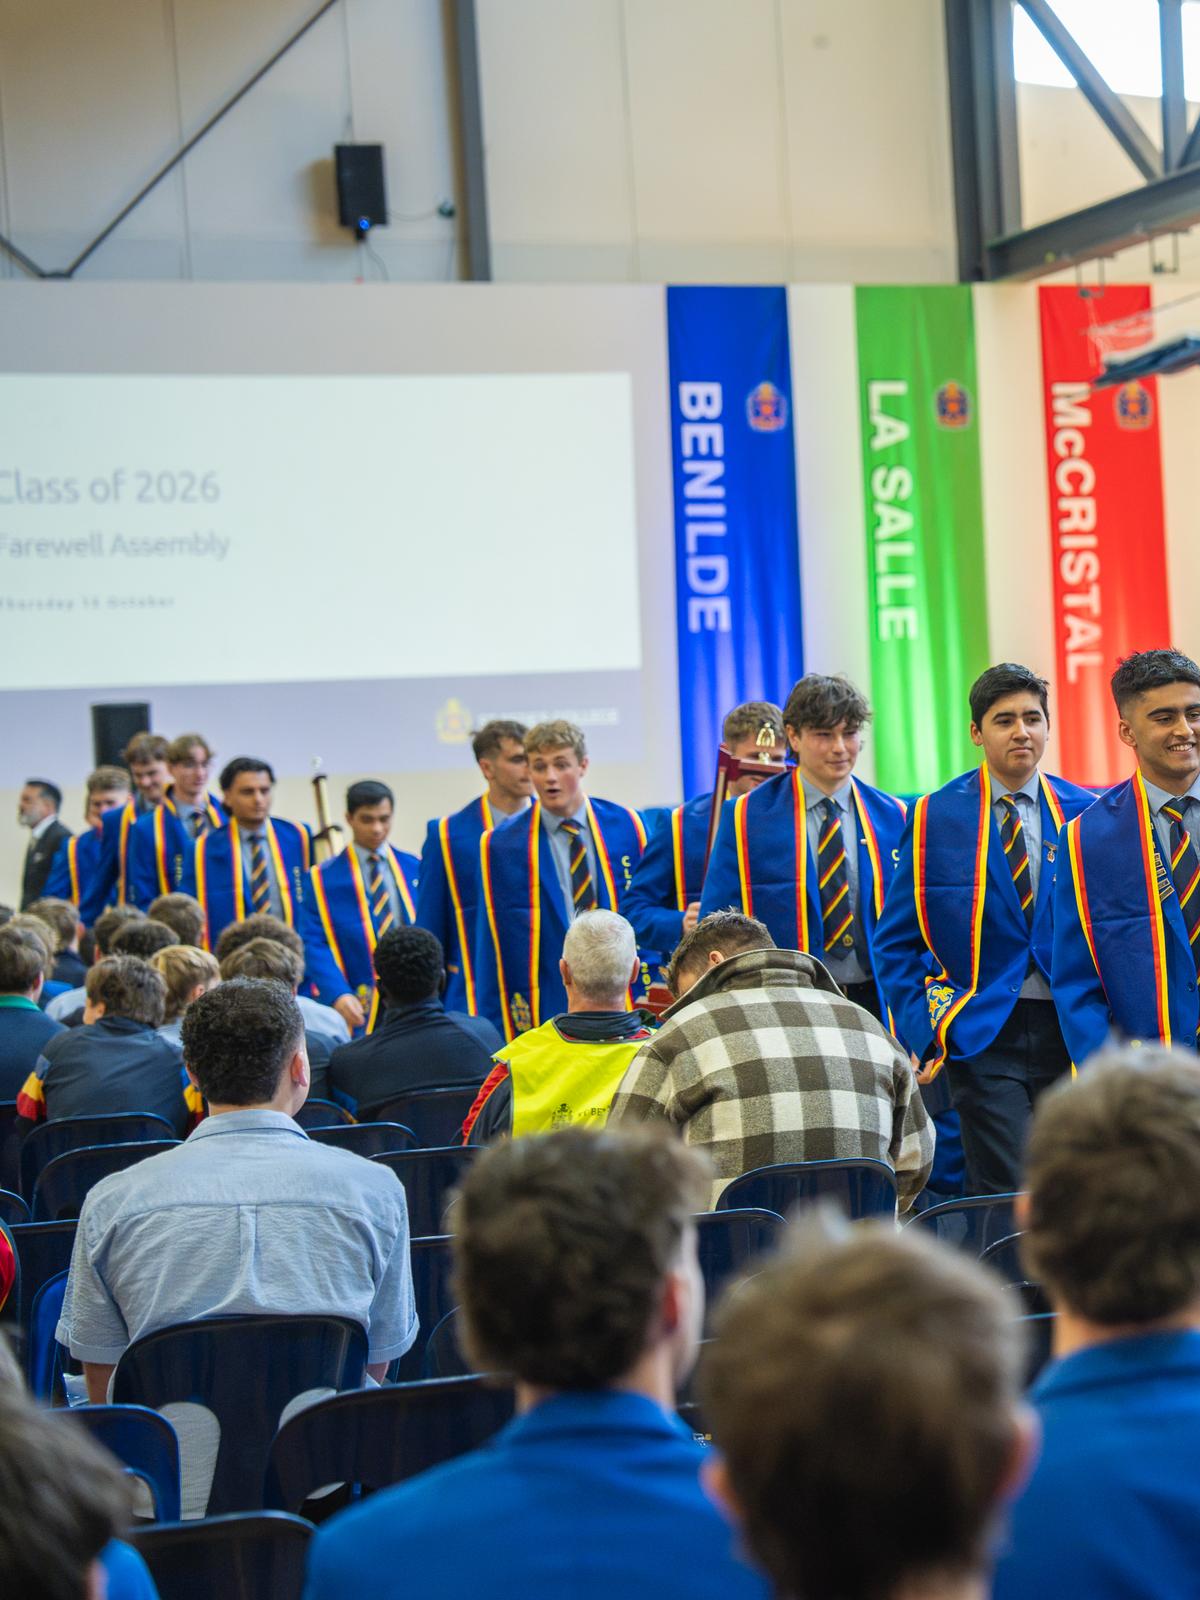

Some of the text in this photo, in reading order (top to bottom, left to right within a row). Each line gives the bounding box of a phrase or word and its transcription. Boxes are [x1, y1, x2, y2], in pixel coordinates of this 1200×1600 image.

[89, 467, 124, 504] of
[136, 469, 222, 504] 2026
[110, 529, 230, 561] Assembly
[679, 381, 731, 633] BENILDE
[868, 380, 919, 642] LA SALLE
[1051, 382, 1103, 684] McCRISTAL
